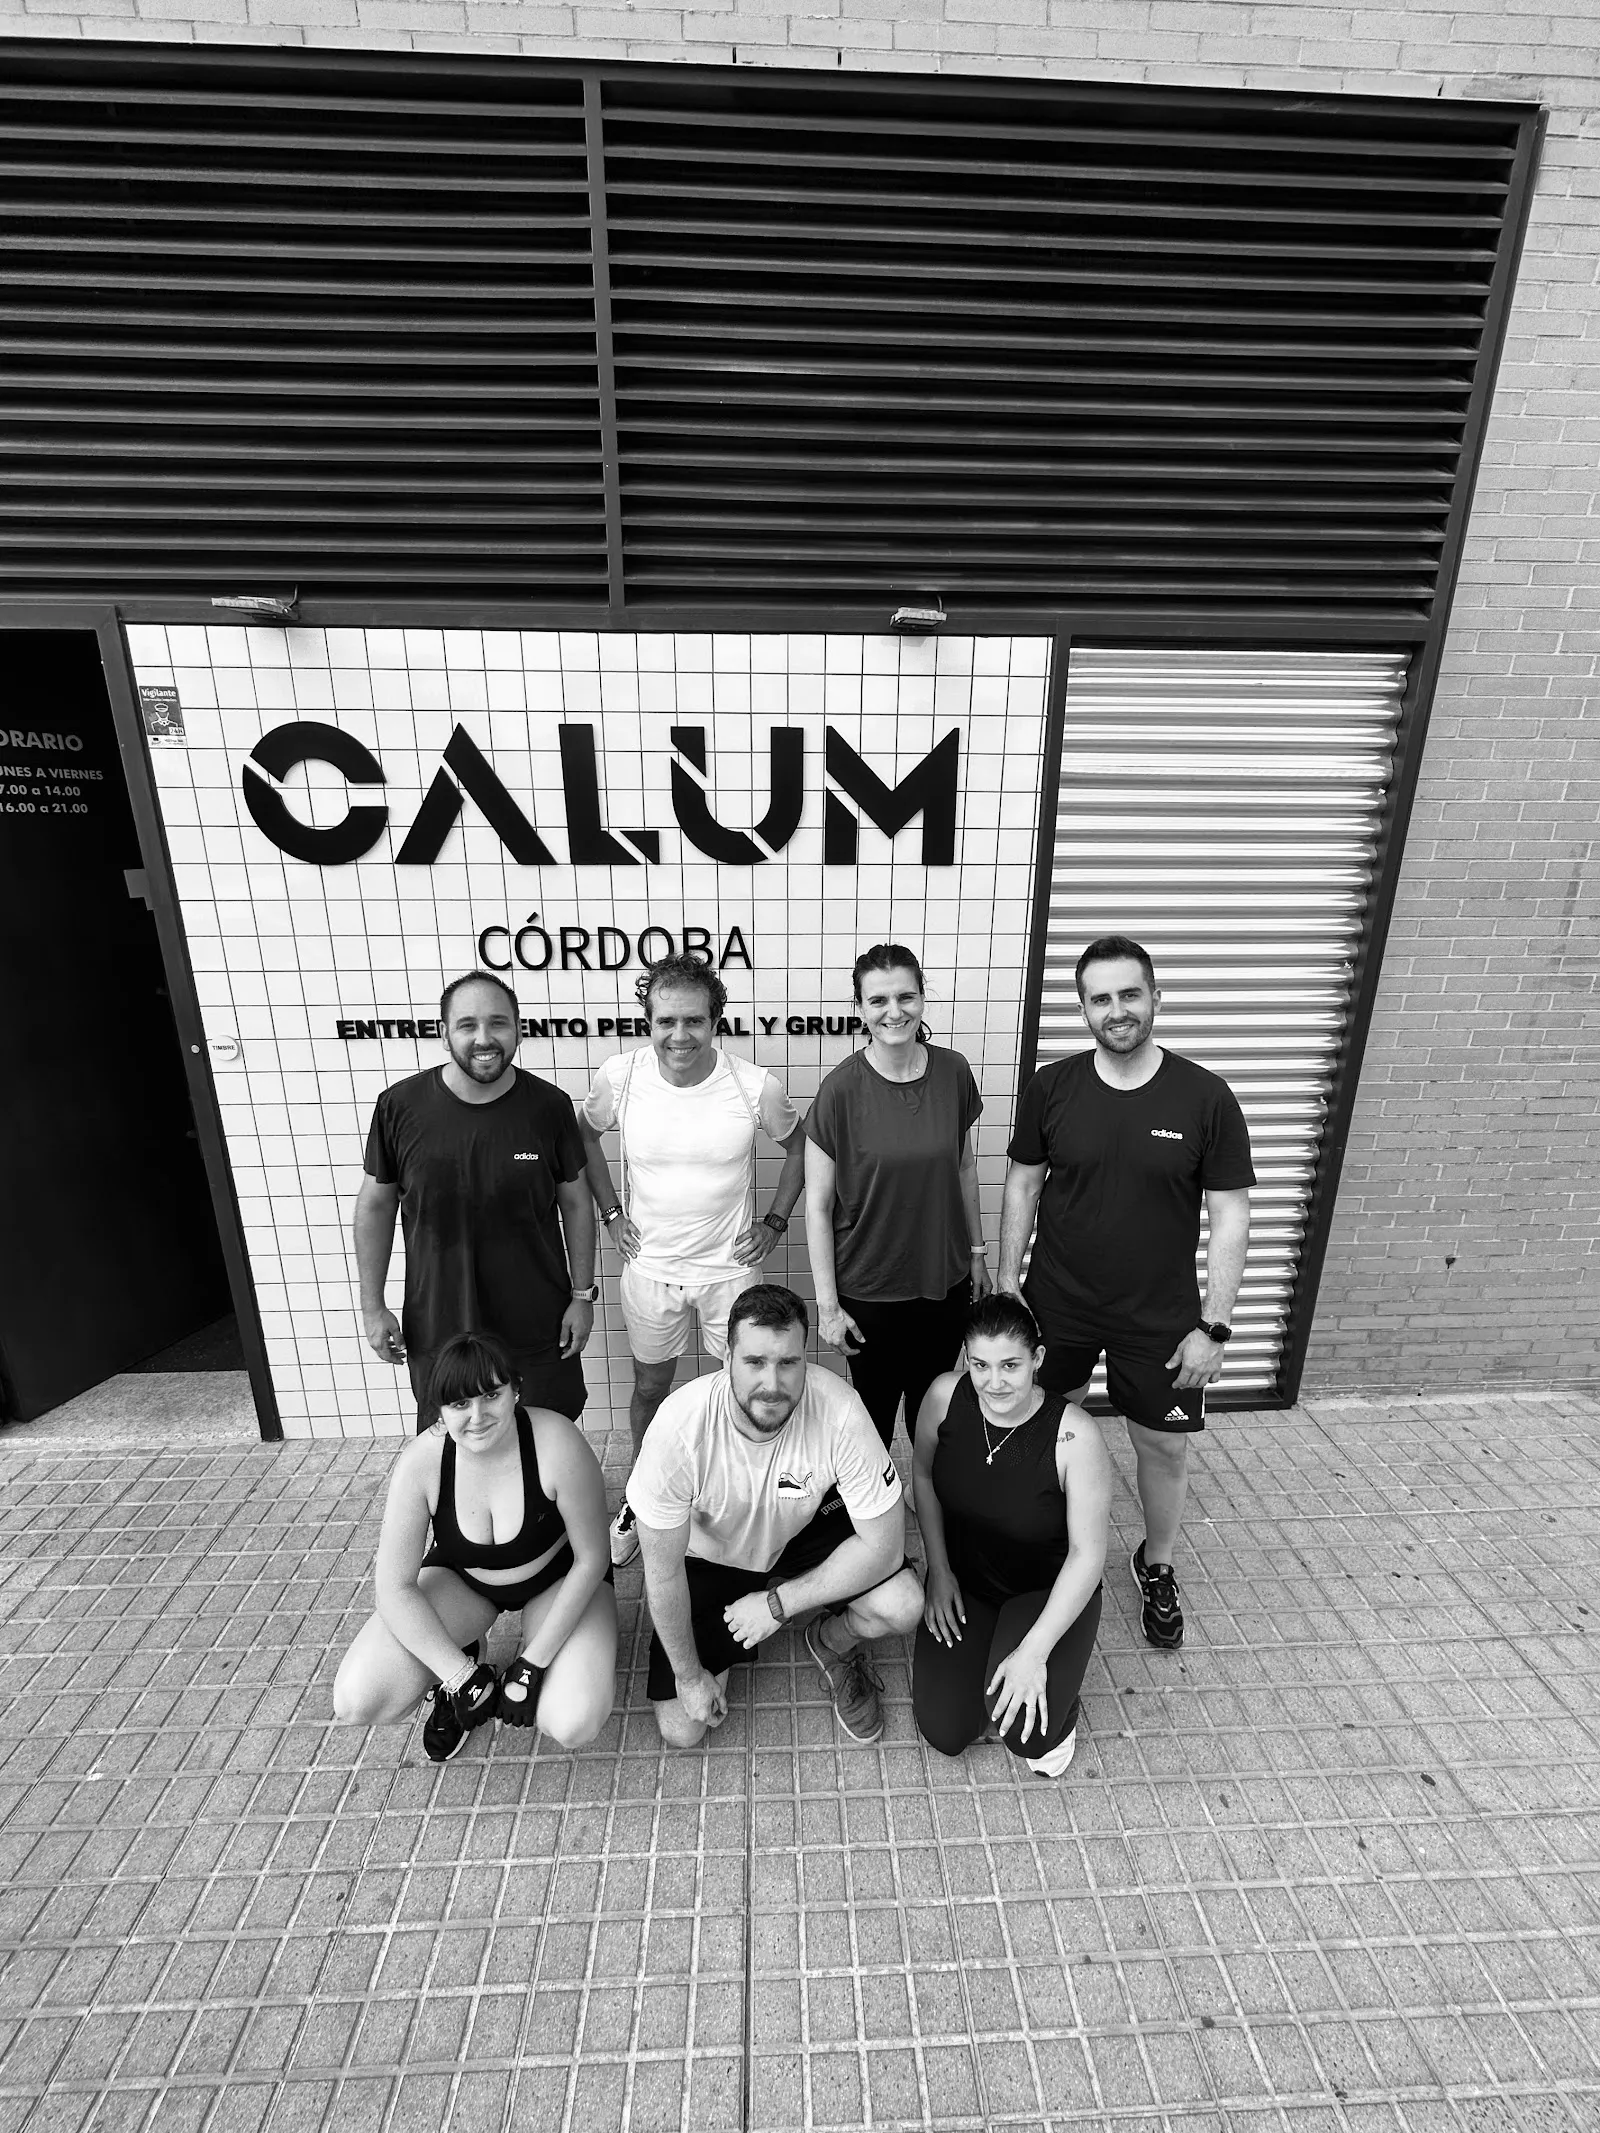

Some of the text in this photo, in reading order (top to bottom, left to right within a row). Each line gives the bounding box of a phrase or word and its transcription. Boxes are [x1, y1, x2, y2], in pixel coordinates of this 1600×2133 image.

[141, 688, 177, 698] Vigilante
[36, 768, 47, 778] A
[48, 768, 104, 780] VIERNES
[31, 787, 41, 796] a
[44, 785, 81, 796] 14.00
[242, 721, 960, 865] CALUM
[39, 805, 49, 813] a
[52, 803, 88, 814] 21.00
[478, 911, 753, 970] CÓRDOBA
[758, 1016, 778, 1036] Y
[1150, 1129, 1183, 1140] adidas
[513, 1152, 539, 1160] adidas
